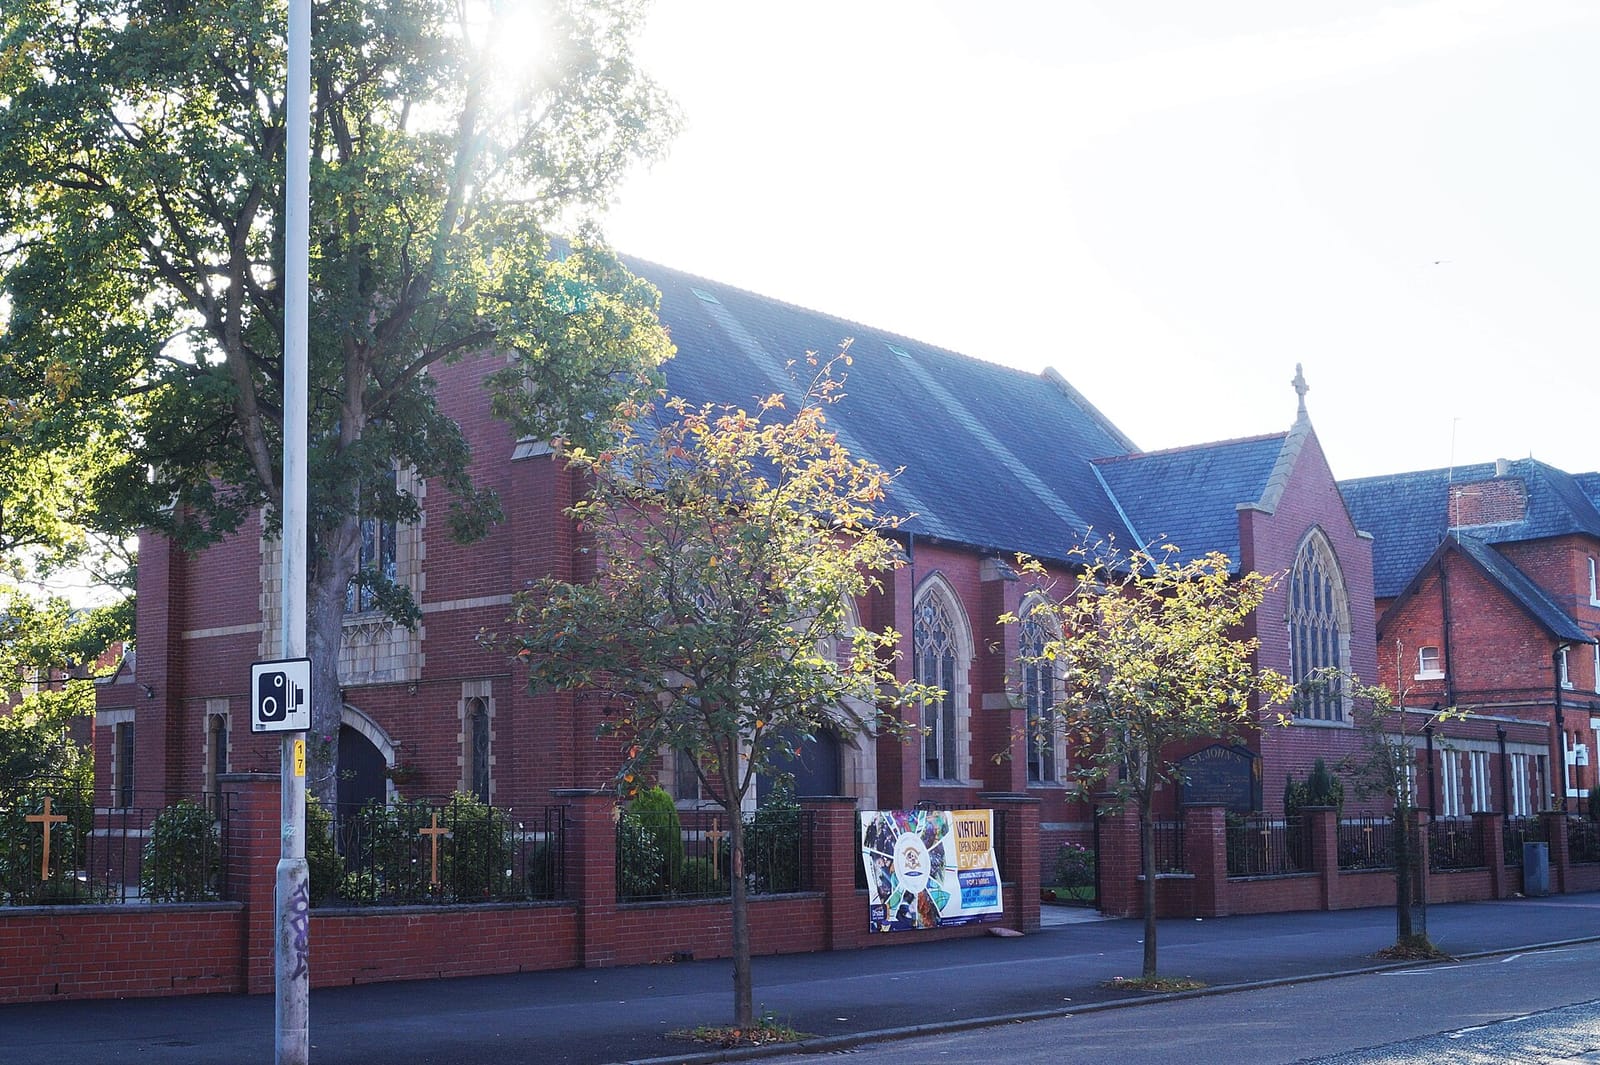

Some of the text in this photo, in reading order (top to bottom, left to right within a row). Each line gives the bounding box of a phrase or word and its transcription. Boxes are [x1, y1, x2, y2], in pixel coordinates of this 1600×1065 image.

[956, 820, 988, 838] VIRTUAL
[959, 840, 988, 852] OPEN SCHOOL
[960, 853, 989, 867] EVENT
